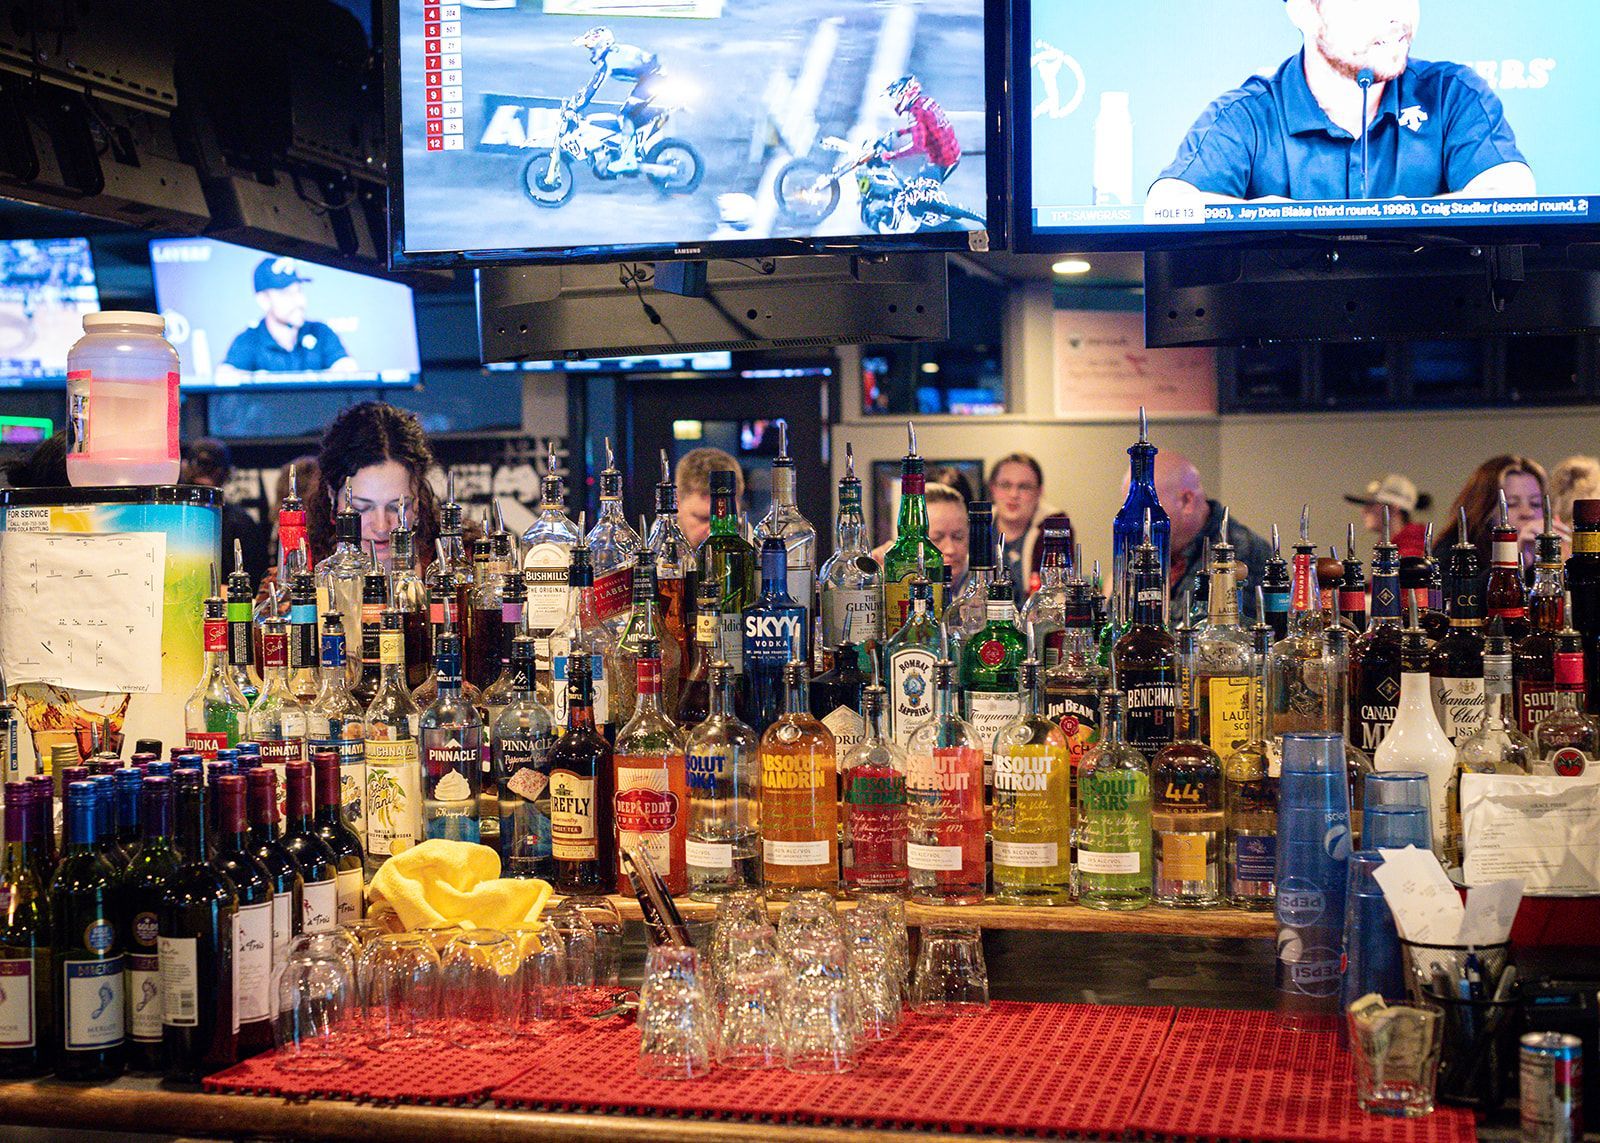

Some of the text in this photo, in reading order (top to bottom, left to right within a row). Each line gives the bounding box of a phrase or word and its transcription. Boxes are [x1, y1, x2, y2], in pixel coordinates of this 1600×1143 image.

[429, 10, 435, 18] 4
[430, 26, 436, 35] 5
[430, 43, 436, 51] 6
[430, 59, 436, 67] 7
[430, 75, 437, 84] 8
[431, 91, 437, 100] 9
[429, 107, 440, 116] 10
[430, 123, 439, 132] 11
[430, 139, 441, 148] 12
[1154, 208, 1194, 218] HOLE 13
[1204, 207, 1234, 220] 995),
[1238, 207, 1258, 220] Jay
[1258, 206, 1280, 218] Don
[1281, 205, 1312, 217] Blake
[1313, 204, 1345, 218] (third
[1345, 204, 1382, 217] round,
[1421, 203, 1451, 216] Craig
[1451, 201, 1492, 213] Stadler
[1492, 199, 1538, 214] (second
[1539, 199, 1576, 213] round,
[8, 510, 49, 518] FOR SERVICE
[526, 571, 568, 581] BUSHMILLS
[600, 584, 629, 599] LABEL
[866, 612, 876, 623] 12
[746, 616, 799, 637] SKYY
[755, 640, 789, 648] VODKA
[898, 659, 930, 674] BOMBAY
[1127, 687, 1175, 709] BENCHMA
[1437, 688, 1486, 707] Canadi
[898, 702, 932, 717] SAPPHIRE
[970, 708, 1018, 723] Tanquera
[1046, 698, 1094, 721] JIM BEAM
[1361, 704, 1398, 721] CANAD
[1450, 706, 1481, 724] Club
[260, 744, 300, 757] ICHNAYA
[309, 743, 364, 756] STHNAYA
[502, 738, 552, 752] PINNACLE
[428, 748, 477, 763] PINNACLE
[685, 755, 725, 773] SOLUT
[550, 796, 590, 816] REFLY
[644, 801, 672, 814] EDDY
